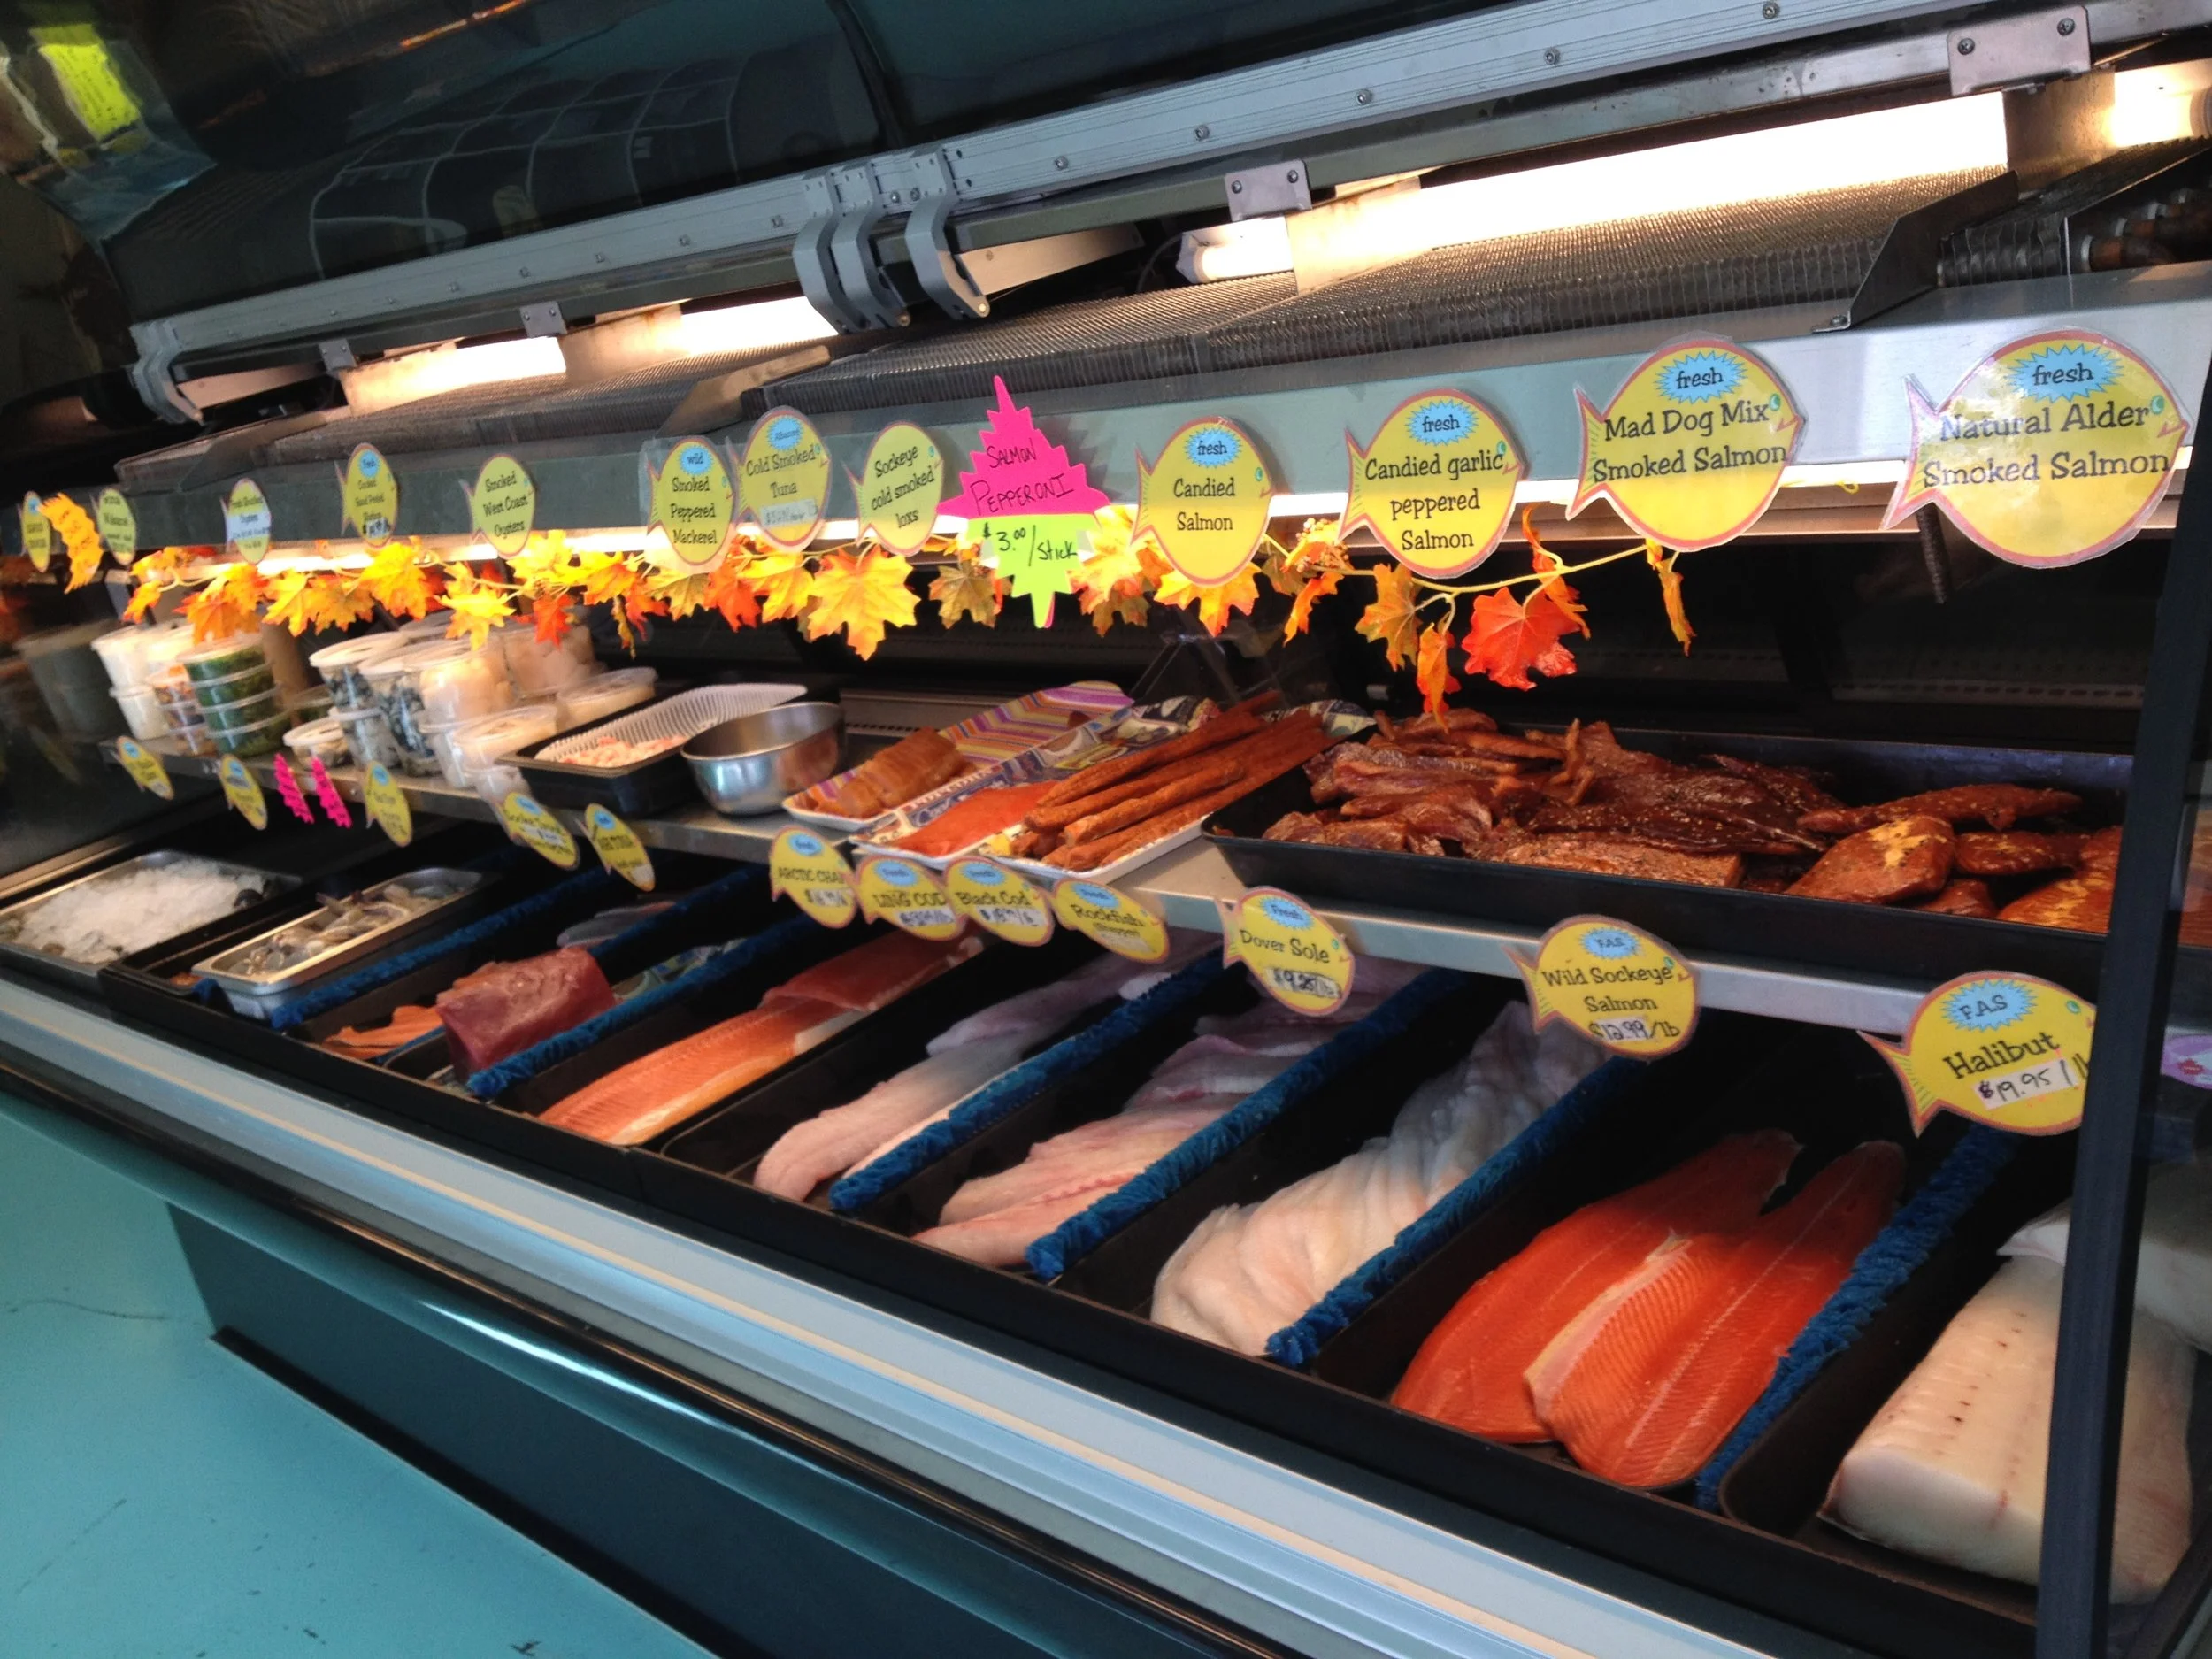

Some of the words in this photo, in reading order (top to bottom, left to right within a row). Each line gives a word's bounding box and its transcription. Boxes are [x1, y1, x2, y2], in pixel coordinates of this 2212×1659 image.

[1675, 367, 1724, 389] fresh
[2032, 362, 2094, 386] fresh
[1422, 414, 1460, 433] fresh
[1604, 412, 1656, 442] Mad
[1663, 409, 1714, 436] Dog
[1720, 400, 1770, 426] Mix
[1939, 406, 2052, 442] Natural
[2060, 401, 2150, 433] Alder
[986, 438, 1036, 468] SALMON
[1197, 441, 1228, 456] fresh
[746, 456, 770, 477] Cold
[771, 444, 817, 471] Smoked
[874, 446, 918, 479] Sockeye
[1365, 453, 1442, 480] Candied
[1448, 449, 1504, 480] garlic
[1593, 450, 1686, 483] Smoked
[1694, 445, 1787, 472] Salmon
[1923, 454, 2040, 489] Smoked
[2050, 451, 2170, 480] Salmon
[485, 471, 517, 493] Smoked
[672, 476, 710, 493] Smoked
[770, 481, 798, 498] Tuna
[871, 487, 893, 511] cold
[895, 465, 935, 499] smoked
[1173, 477, 1236, 497] Candied
[483, 502, 504, 517] West
[504, 494, 528, 511] Coast
[970, 473, 1074, 518] PEPPERONI
[1390, 488, 1480, 521] peppered
[670, 503, 716, 523] Peppered
[895, 510, 919, 528] loxs
[1177, 511, 1233, 531] Salmon
[672, 529, 718, 544] Mackerel
[1402, 530, 1474, 550] Salmon
[955, 892, 997, 905] Black
[999, 890, 1032, 906] Cod
[1070, 903, 1145, 927] Rockfish
[1270, 903, 1304, 921] Fresh
[1240, 929, 1285, 952] Dover
[1289, 938, 1331, 964] Sole
[1542, 971, 1588, 987] Wild
[1590, 965, 1673, 985] Sockeye
[1584, 995, 1658, 1013] Salmon
[1943, 1032, 2062, 1079] Halibut
